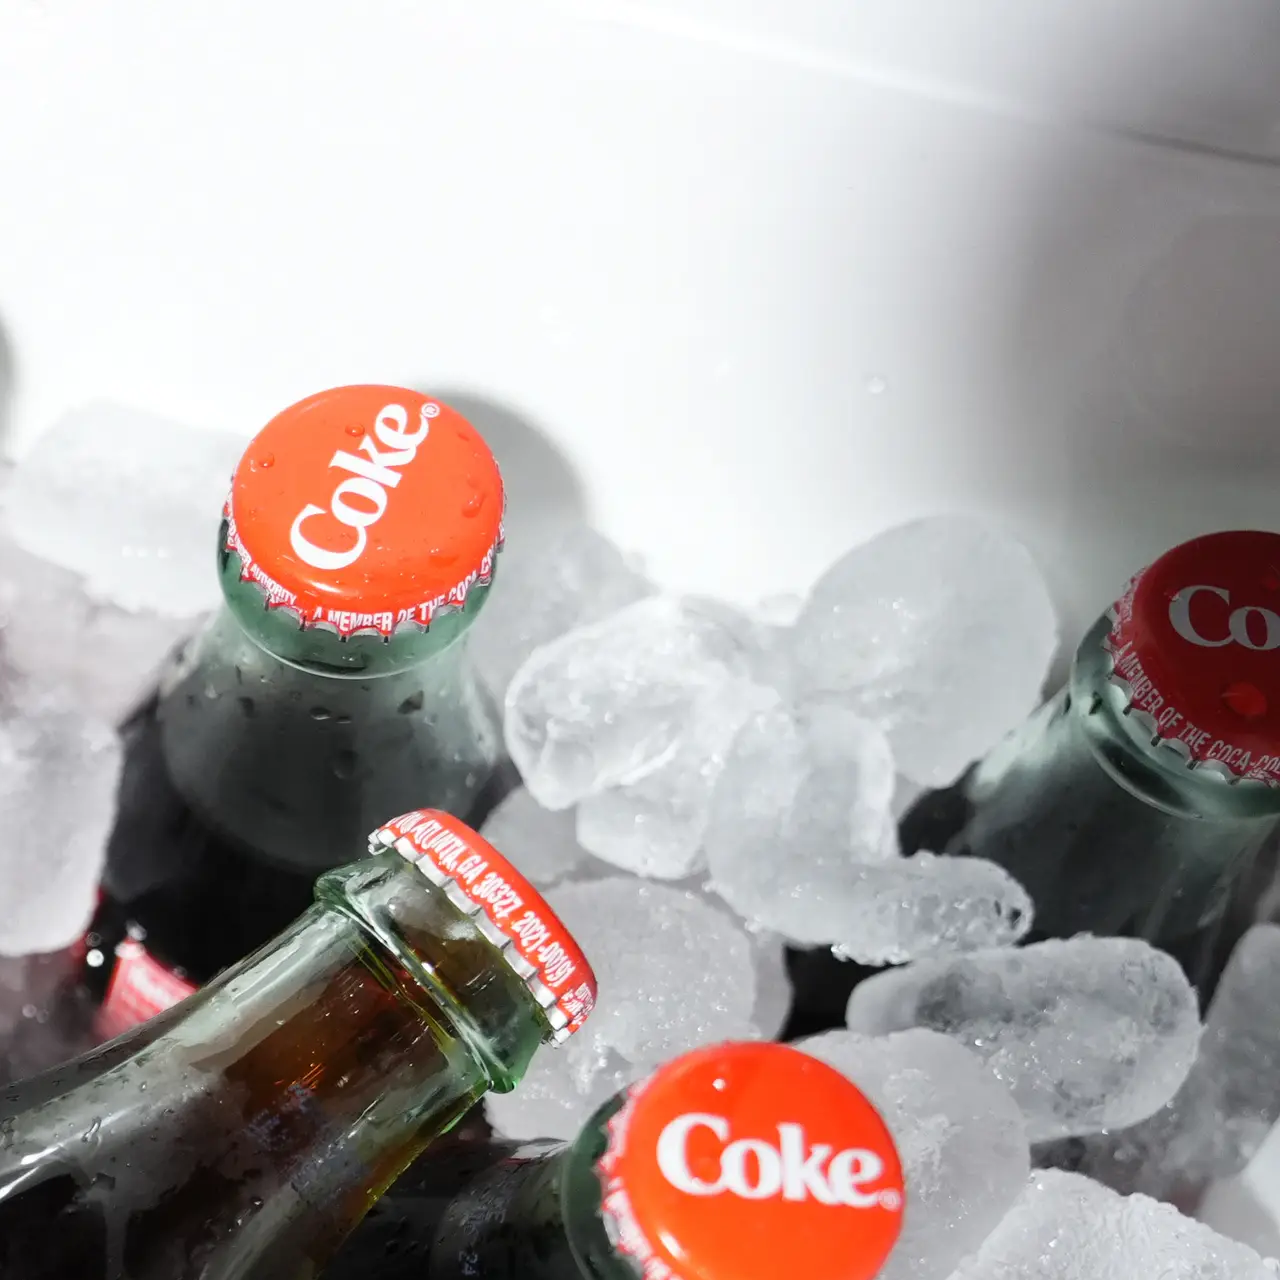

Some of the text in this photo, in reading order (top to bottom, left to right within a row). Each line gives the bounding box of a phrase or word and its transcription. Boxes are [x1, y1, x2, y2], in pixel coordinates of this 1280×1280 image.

[290, 404, 429, 570] Coke
[327, 610, 392, 632] MEMBER
[1168, 585, 1280, 651] Co
[1119, 652, 1165, 716] MEMBER
[1158, 706, 1184, 729] OF
[1177, 722, 1212, 753] THE
[456, 854, 489, 885] GA
[656, 1112, 884, 1209] Coke
